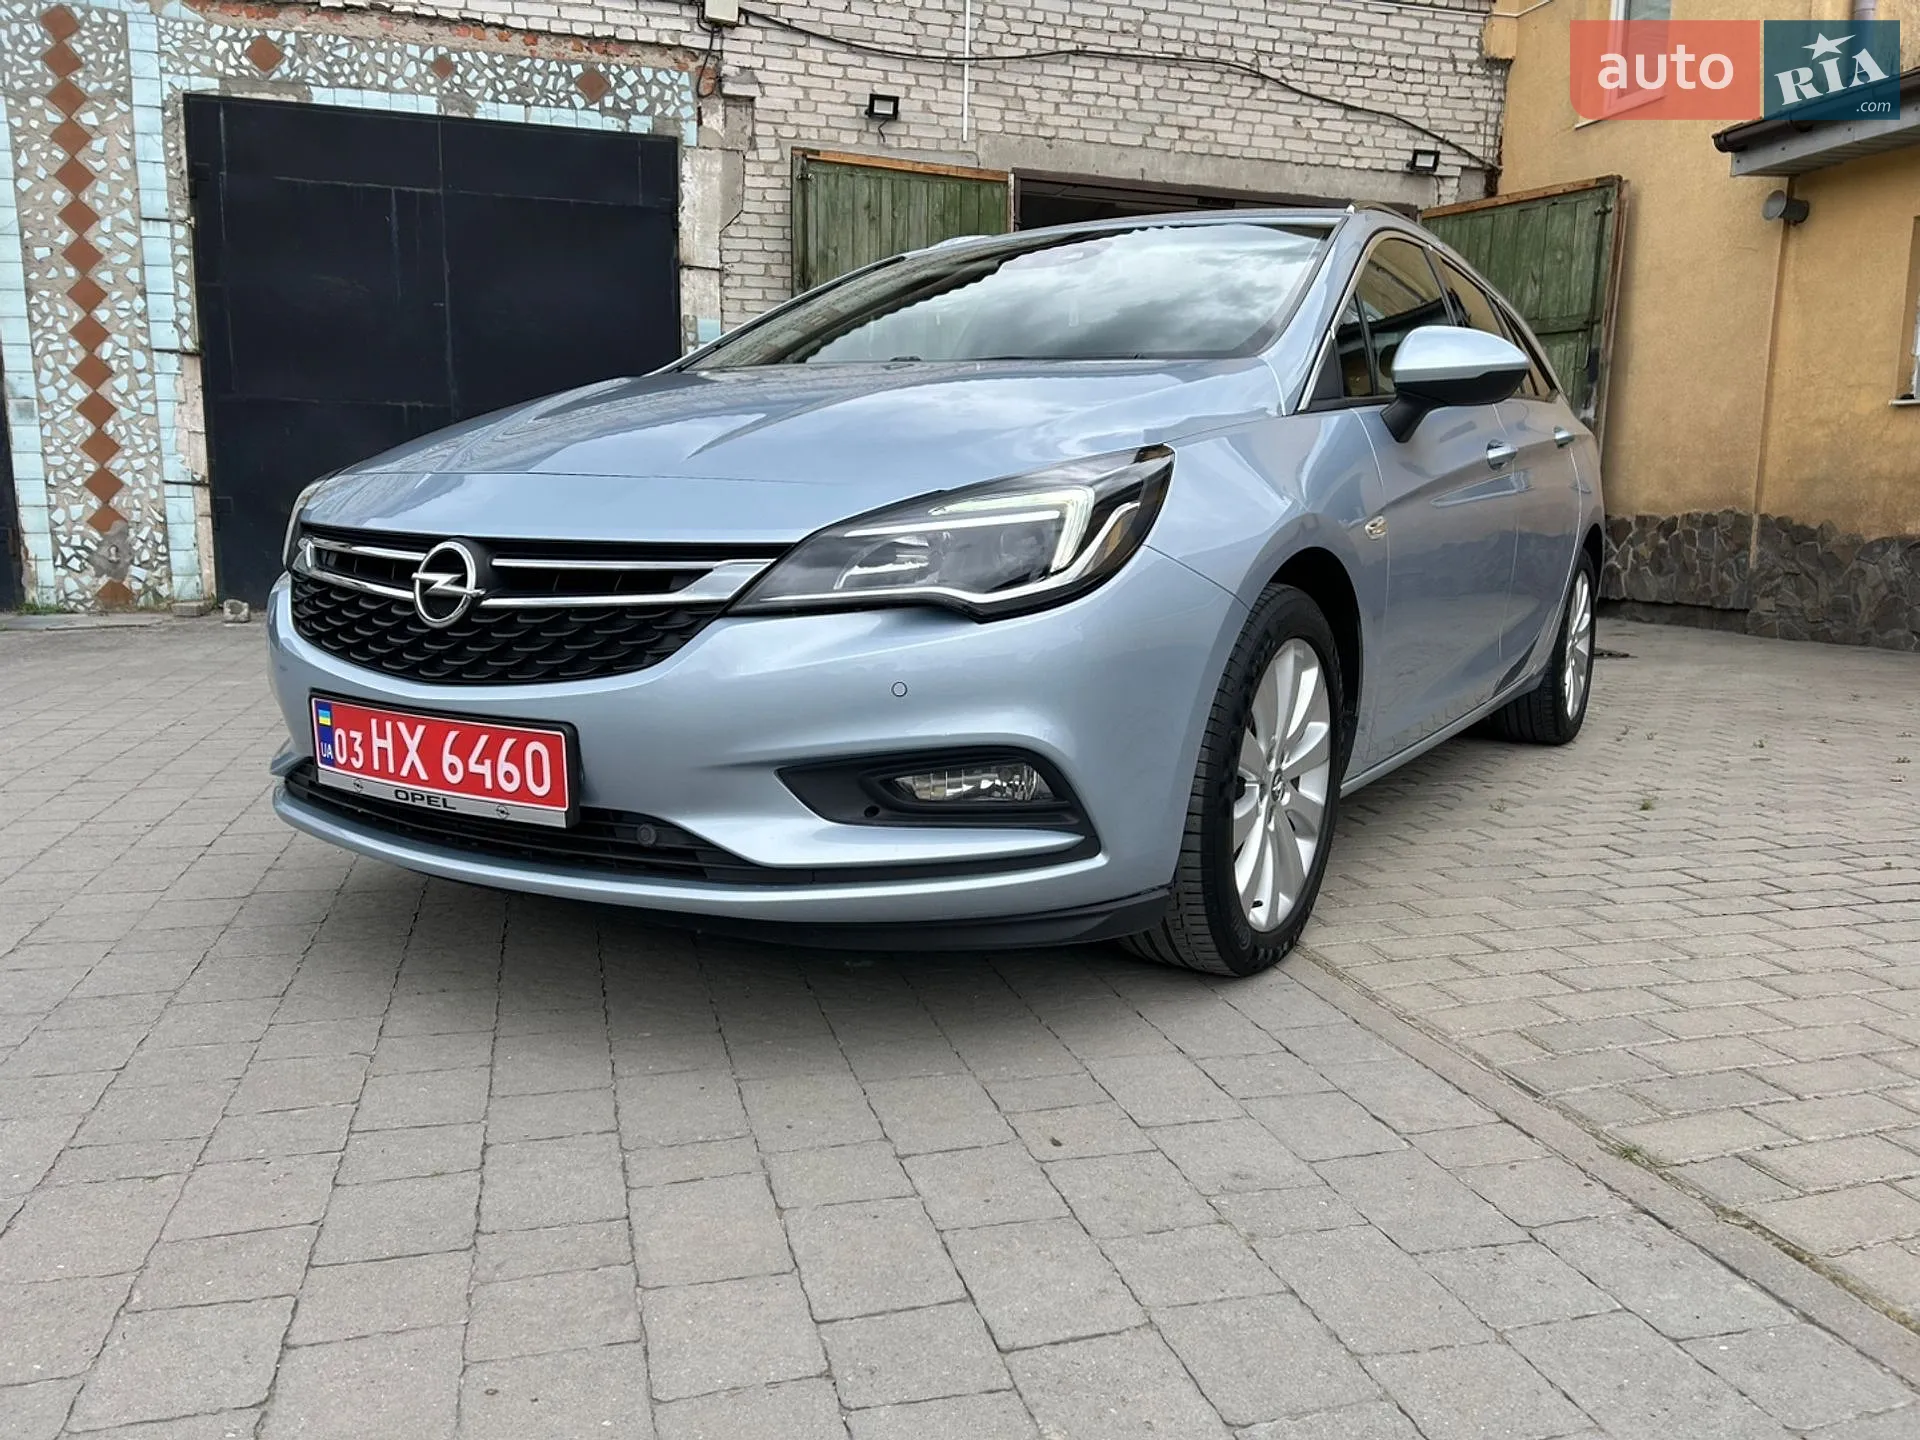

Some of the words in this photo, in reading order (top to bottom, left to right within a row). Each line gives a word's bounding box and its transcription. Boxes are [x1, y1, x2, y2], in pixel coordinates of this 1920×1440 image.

[320, 741, 334, 760] UA
[442, 730, 551, 797] 6460
[394, 788, 456, 810] OPEL
